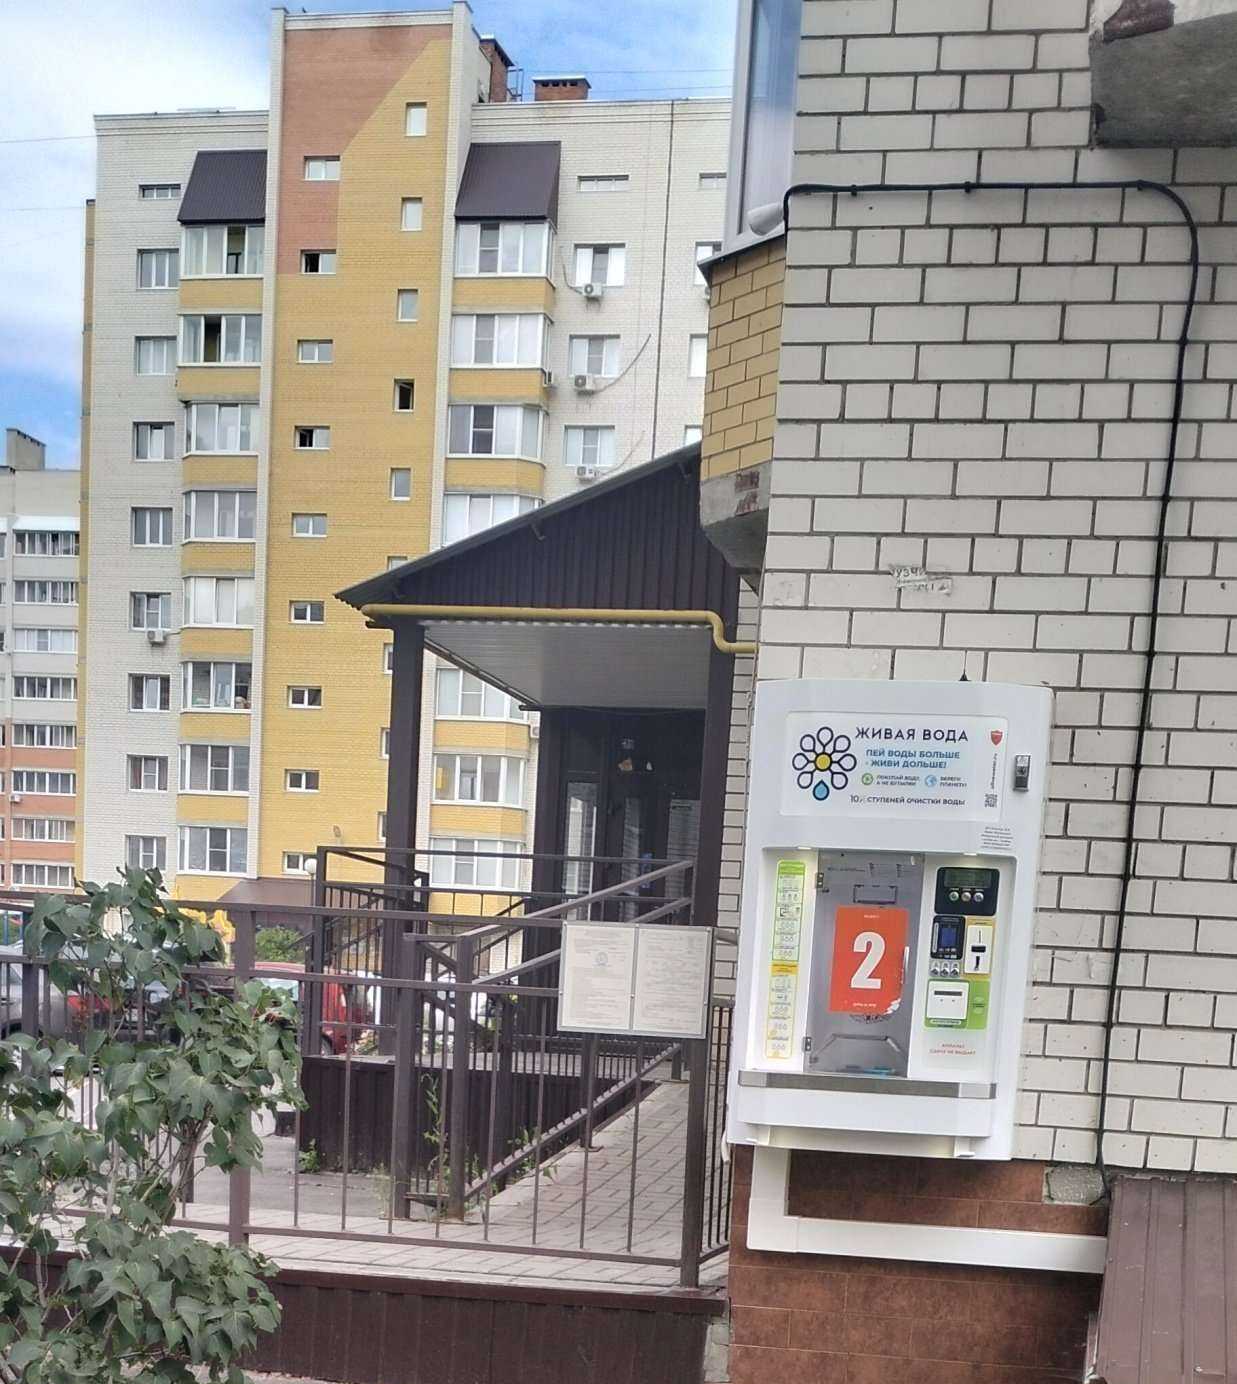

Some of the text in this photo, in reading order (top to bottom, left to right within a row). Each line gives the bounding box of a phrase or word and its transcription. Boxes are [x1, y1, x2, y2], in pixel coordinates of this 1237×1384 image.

[855, 726, 969, 743] ЖИВАЯ ВОДА
[866, 748, 961, 759] ПЕЙ ВОДЫ БОЛЬШЕ
[871, 759, 900, 768] ЖИВИ
[902, 760, 947, 769] ДОЛЬШЕ!
[866, 796, 905, 804] СТУПЕНЕЙ
[906, 797, 941, 805] ОЧИСТКИ
[942, 798, 966, 806] ВОДЫ
[850, 931, 886, 990] 2
